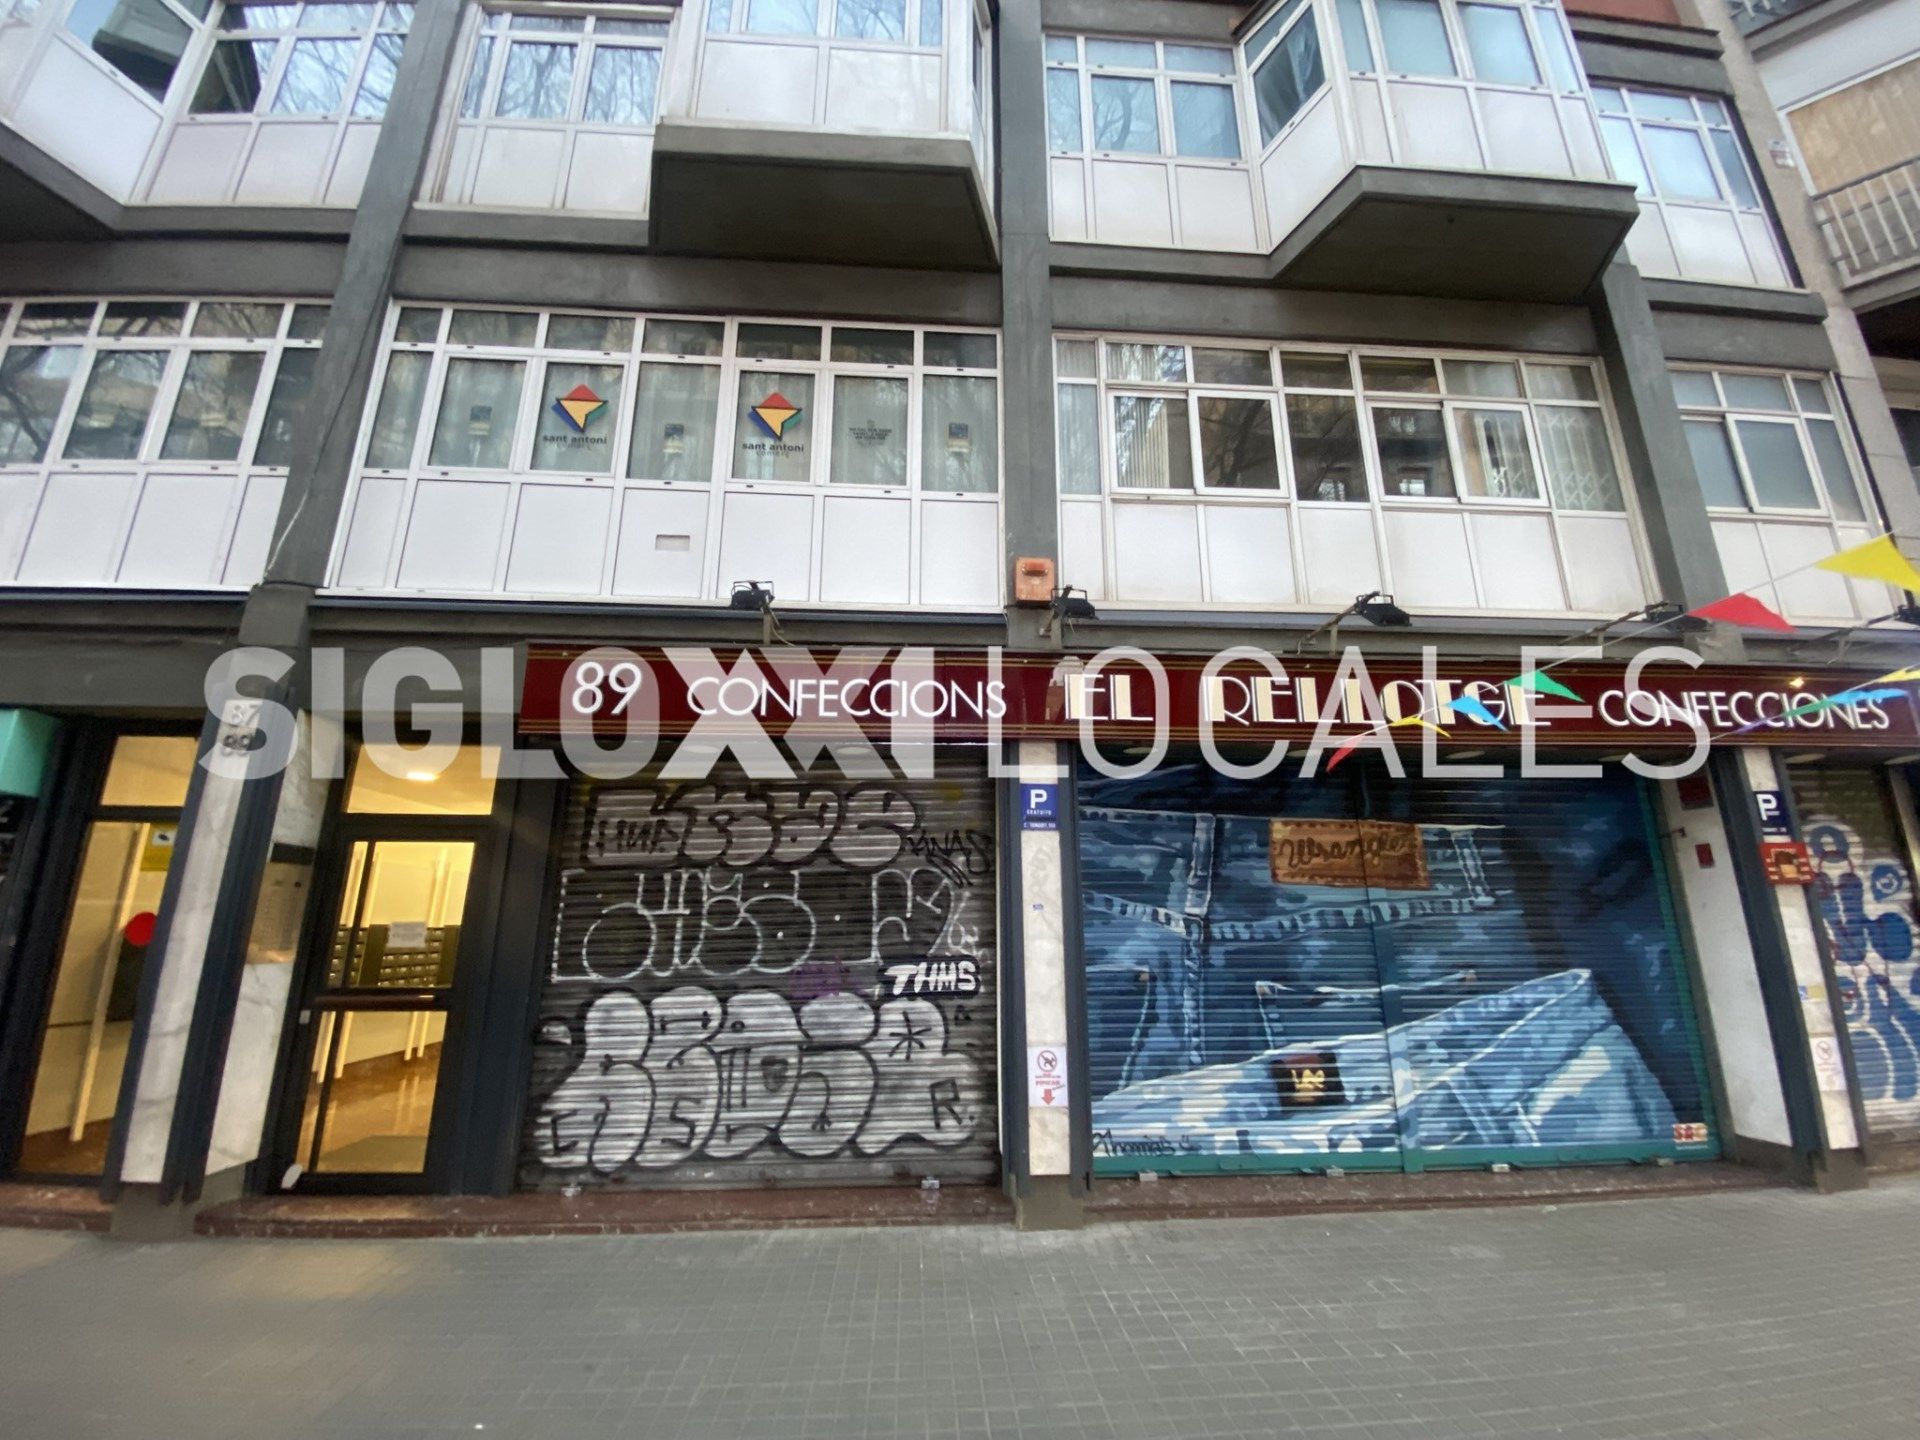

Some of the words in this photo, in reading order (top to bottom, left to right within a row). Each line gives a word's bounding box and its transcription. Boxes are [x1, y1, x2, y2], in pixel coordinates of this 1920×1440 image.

[543, 434, 567, 443] sant
[571, 435, 608, 445] antoni
[742, 443, 766, 451] sant
[769, 443, 805, 453] antoni
[571, 661, 643, 715] 89
[687, 676, 1008, 719] CONFECCIONS
[1064, 674, 1154, 721] EL
[1202, 675, 1552, 727] RELLOTGE
[1599, 689, 1890, 730] CONFECCIONES
[1030, 788, 1048, 809] P
[1756, 793, 1778, 821] P
[884, 960, 977, 996] THMS
